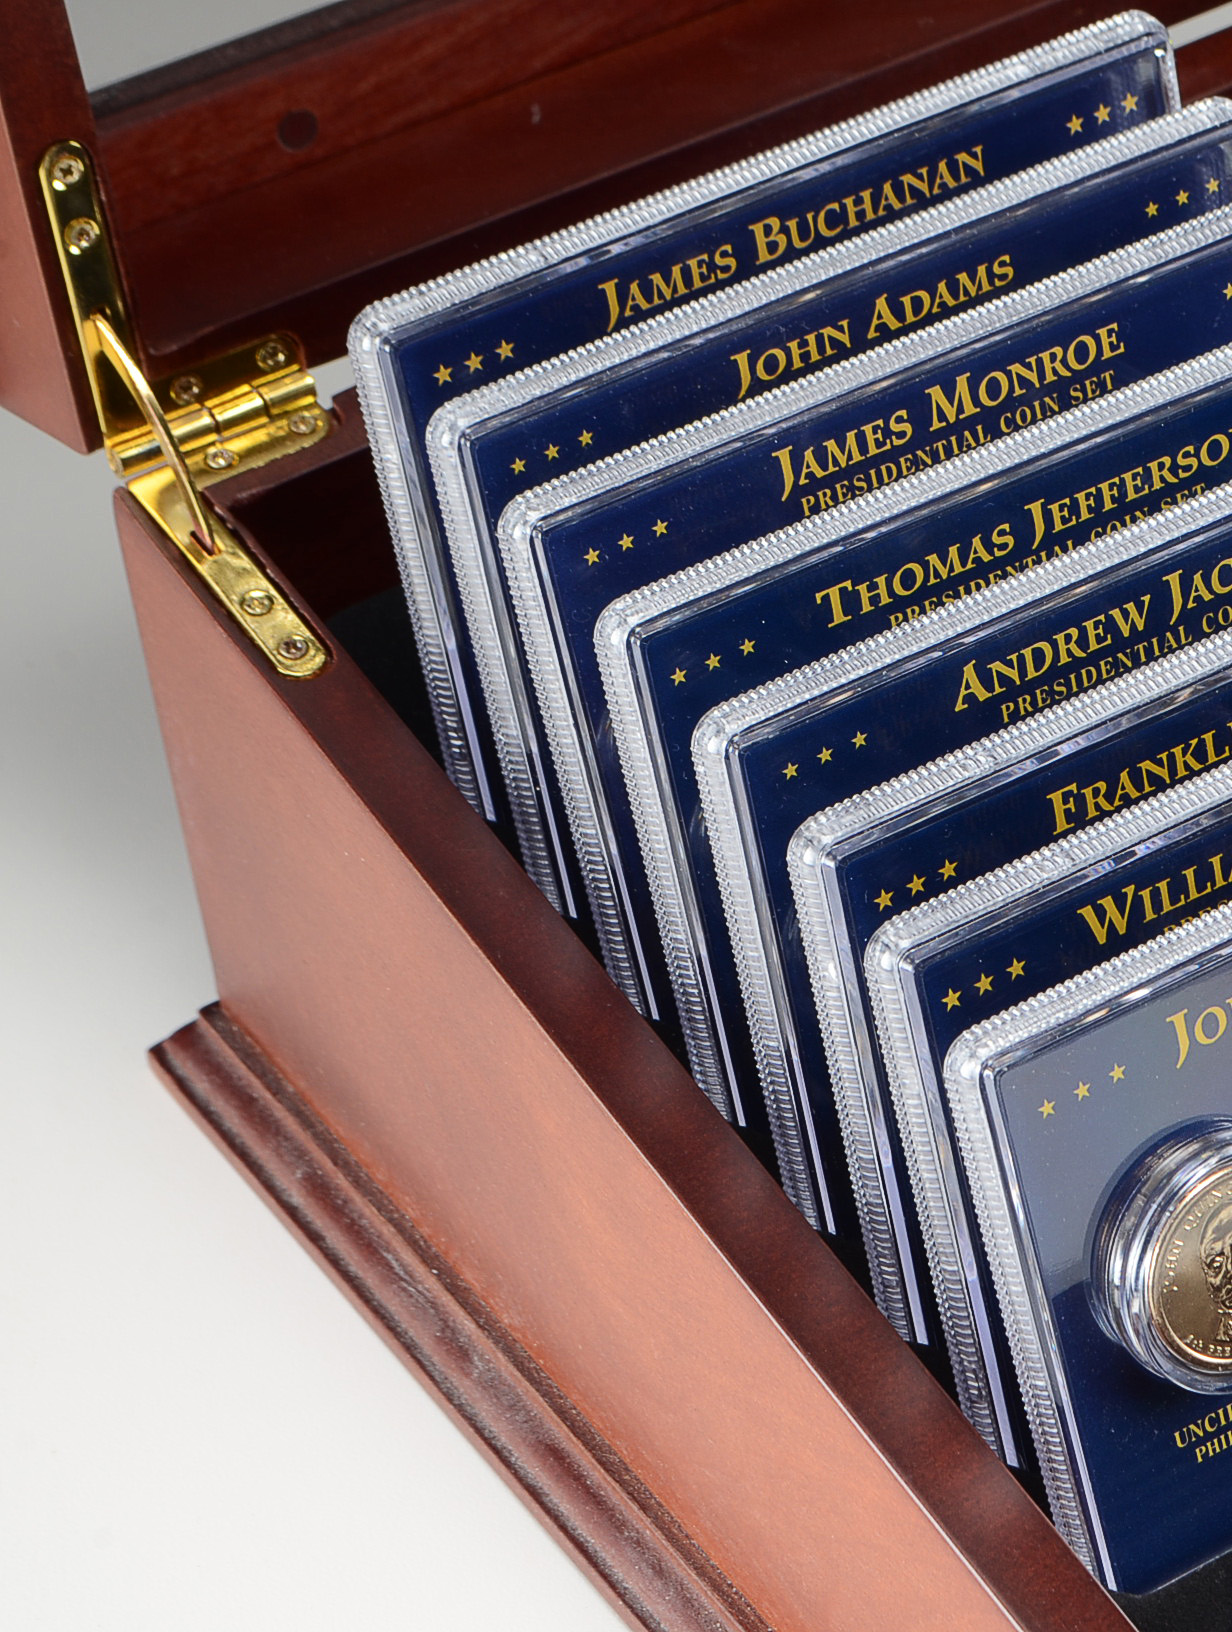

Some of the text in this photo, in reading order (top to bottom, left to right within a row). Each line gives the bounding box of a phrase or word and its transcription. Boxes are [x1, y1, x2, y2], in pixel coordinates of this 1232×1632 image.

[598, 145, 986, 332] JAMES BUCHANAN
[730, 254, 1014, 399] JOHN ADAMS
[772, 322, 1125, 501] JAMES MONROE
[801, 370, 1116, 517] PRESIDENTIAL COIN SET
[816, 523, 1015, 628] THOMAS
[954, 595, 1151, 712] ANDREW
[1001, 626, 1193, 724] PRESIDENTIAL
